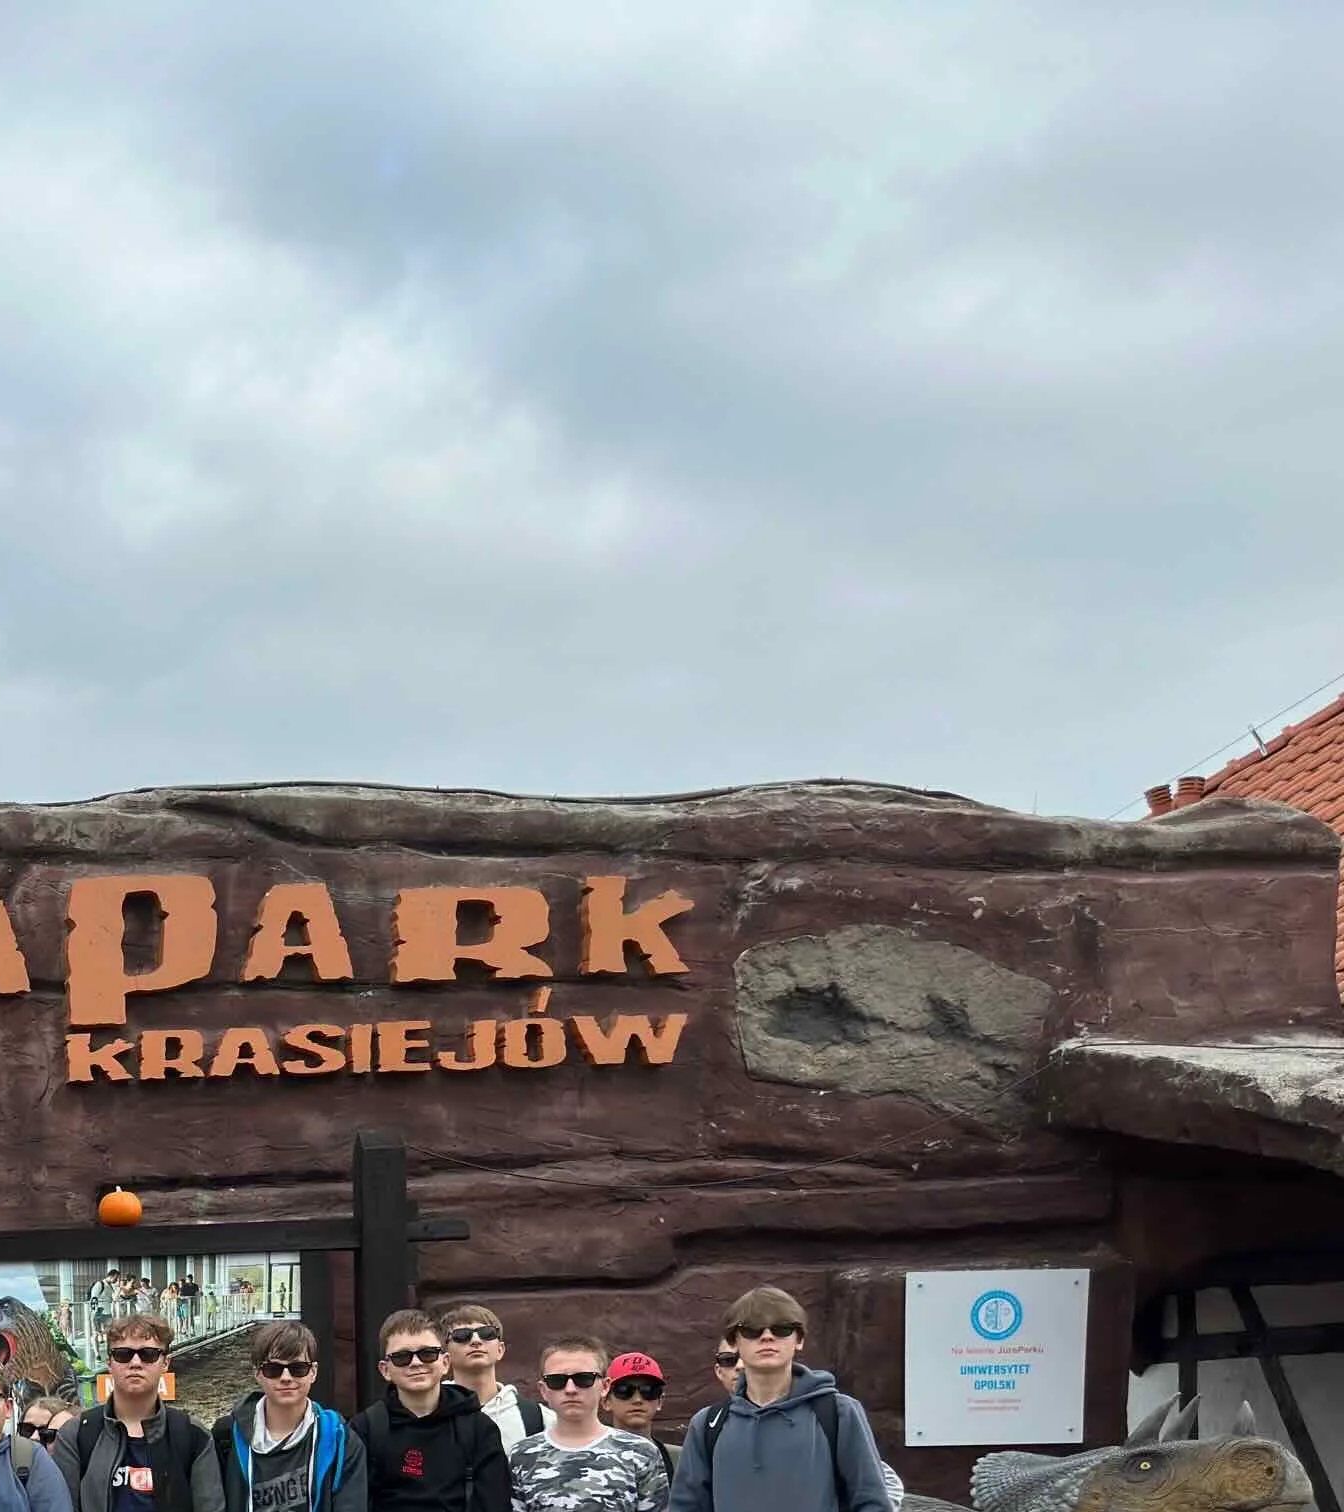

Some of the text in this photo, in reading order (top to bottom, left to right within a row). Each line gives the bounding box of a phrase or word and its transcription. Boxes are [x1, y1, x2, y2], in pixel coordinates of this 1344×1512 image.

[65, 986, 688, 1084] KRASIEJÓW
[960, 1363, 1030, 1376] UNIWERSYTET
[974, 1379, 1016, 1391] OPOLSKI
